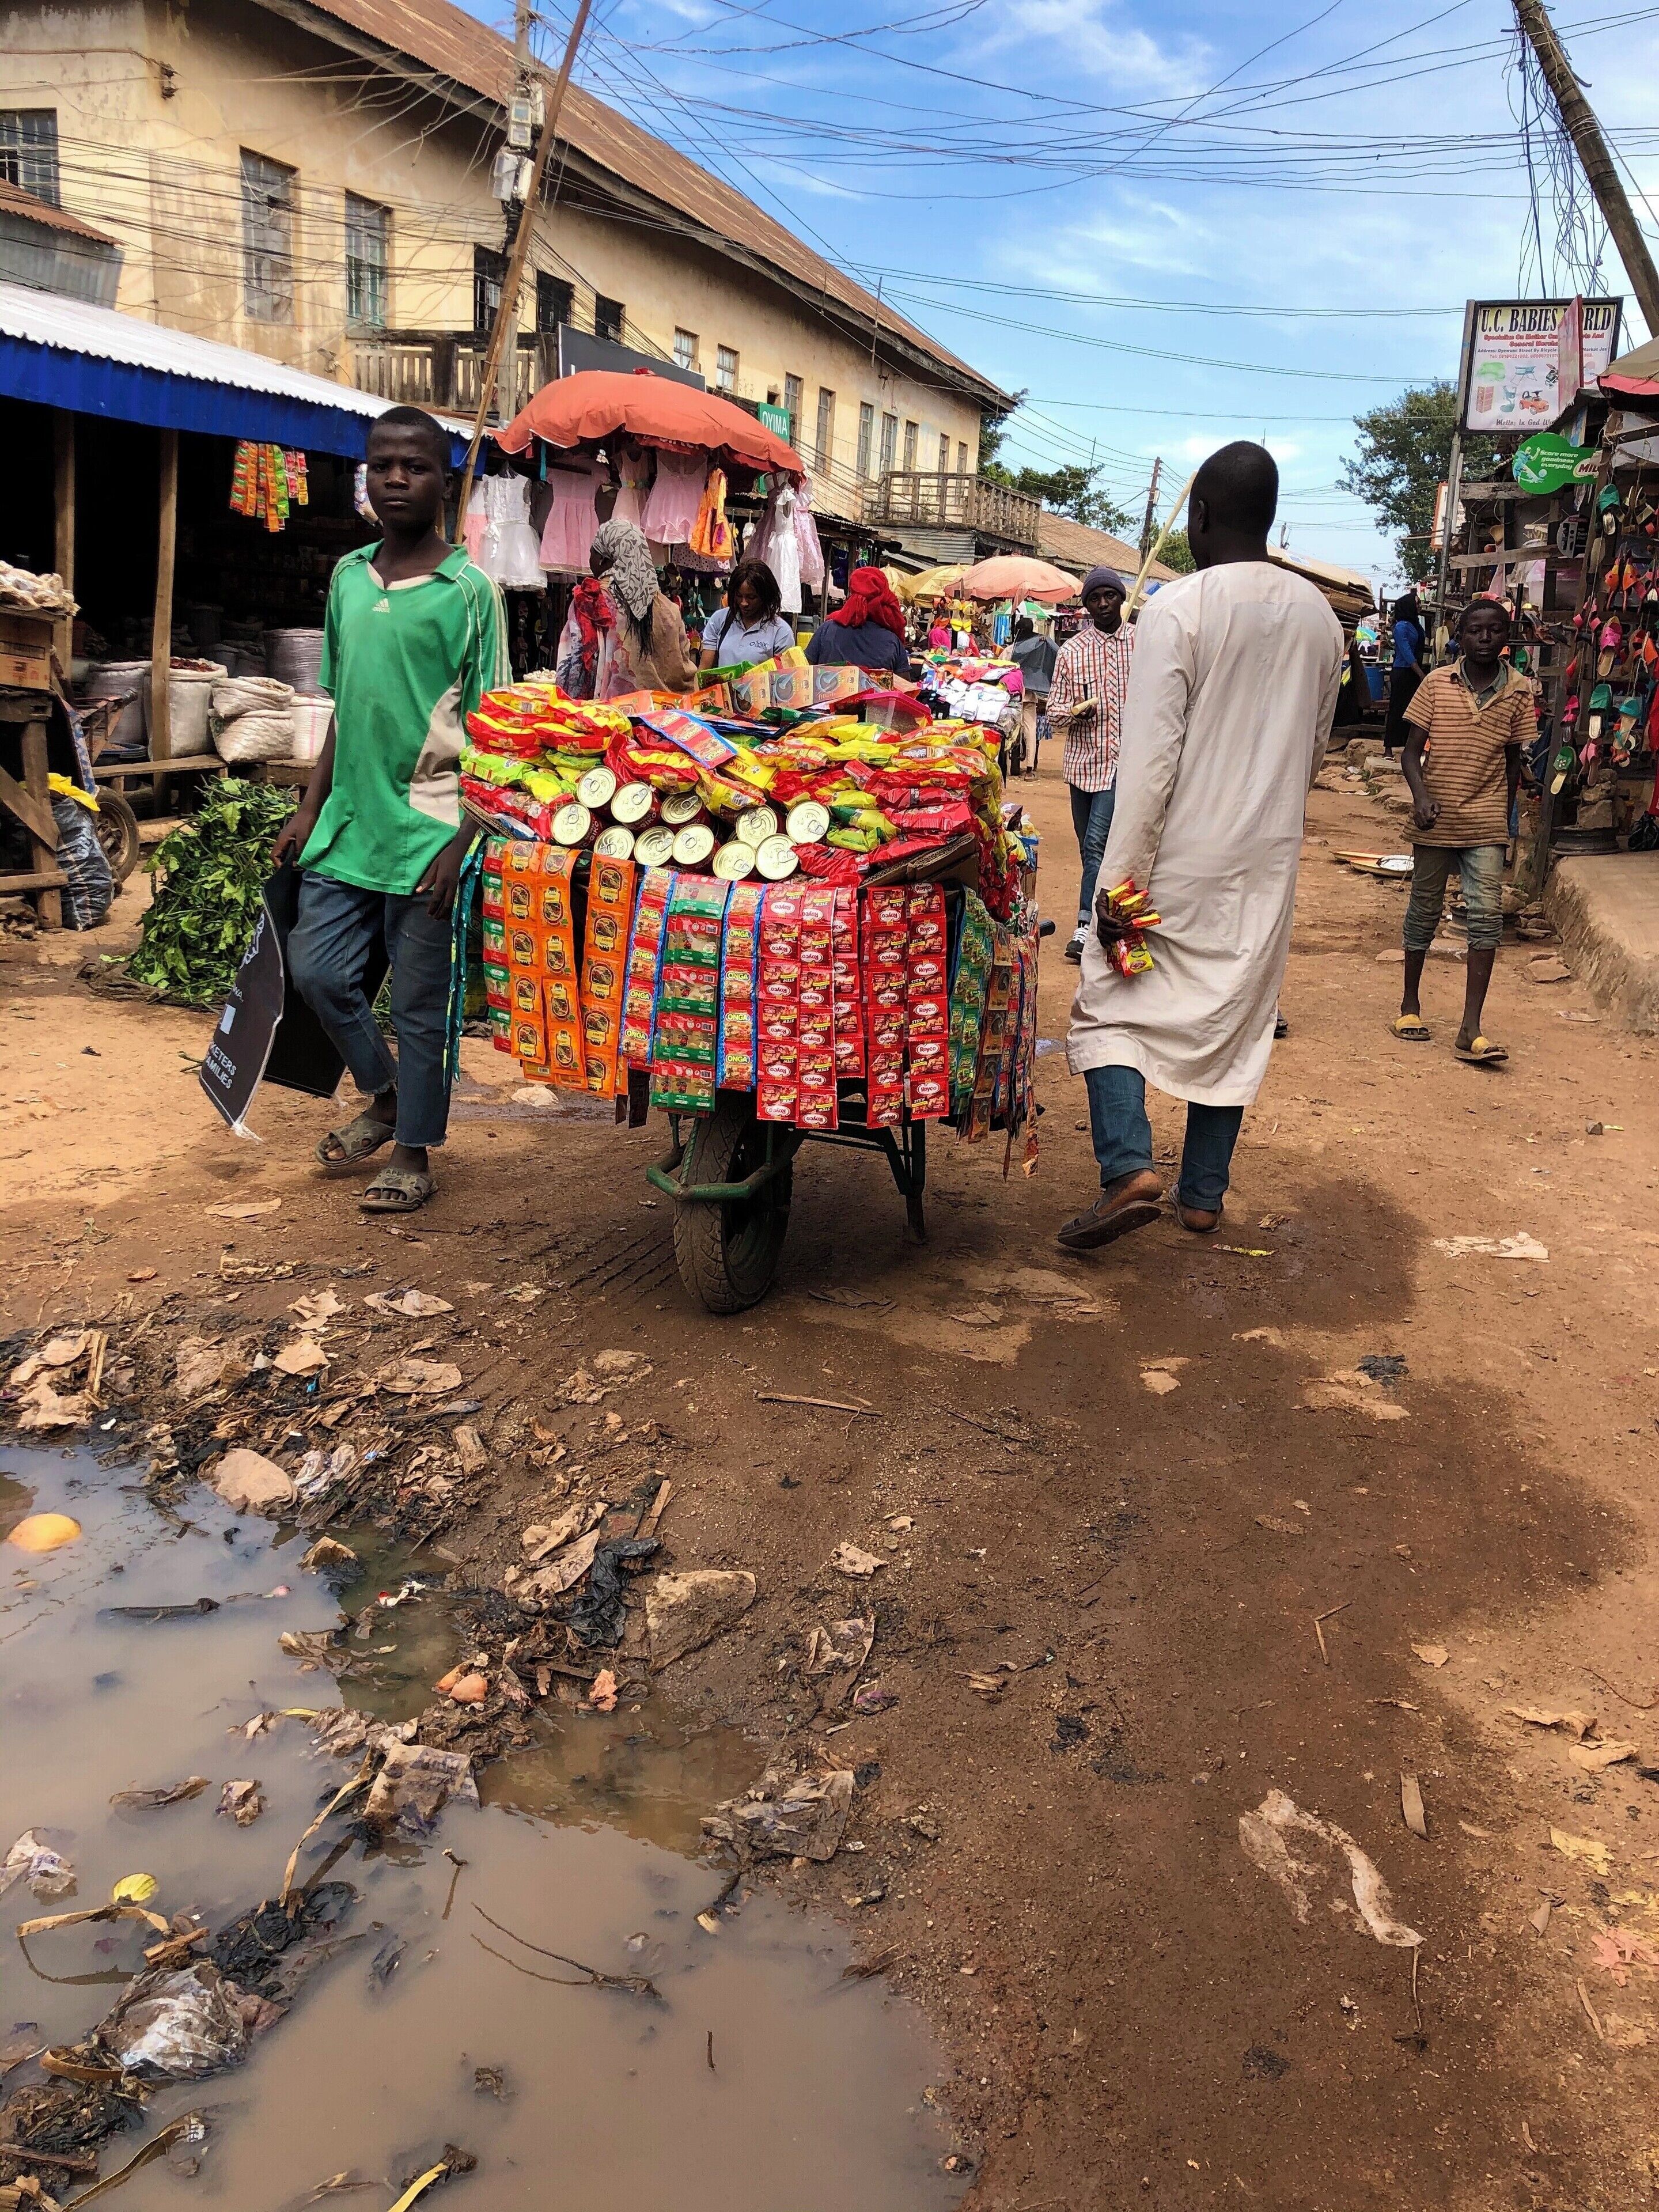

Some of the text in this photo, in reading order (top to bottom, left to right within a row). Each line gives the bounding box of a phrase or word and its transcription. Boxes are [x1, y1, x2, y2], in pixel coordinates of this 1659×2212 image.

[1482, 307, 1612, 332] U.C. BABIES RLD
[762, 410, 788, 435] OYIMA
[1578, 464, 1599, 472] MIL
[650, 868, 669, 878] ONGA
[641, 909, 660, 919] ONGA
[729, 930, 750, 938] ONGA
[634, 950, 653, 960] ONGA
[801, 953, 819, 961] Royco
[727, 972, 749, 980] ONGA
[630, 991, 650, 1000] ONGA
[626, 1031, 646, 1039] ONGA
[211, 1042, 237, 1076] KETERS
[206, 1054, 232, 1089] AMILIES
